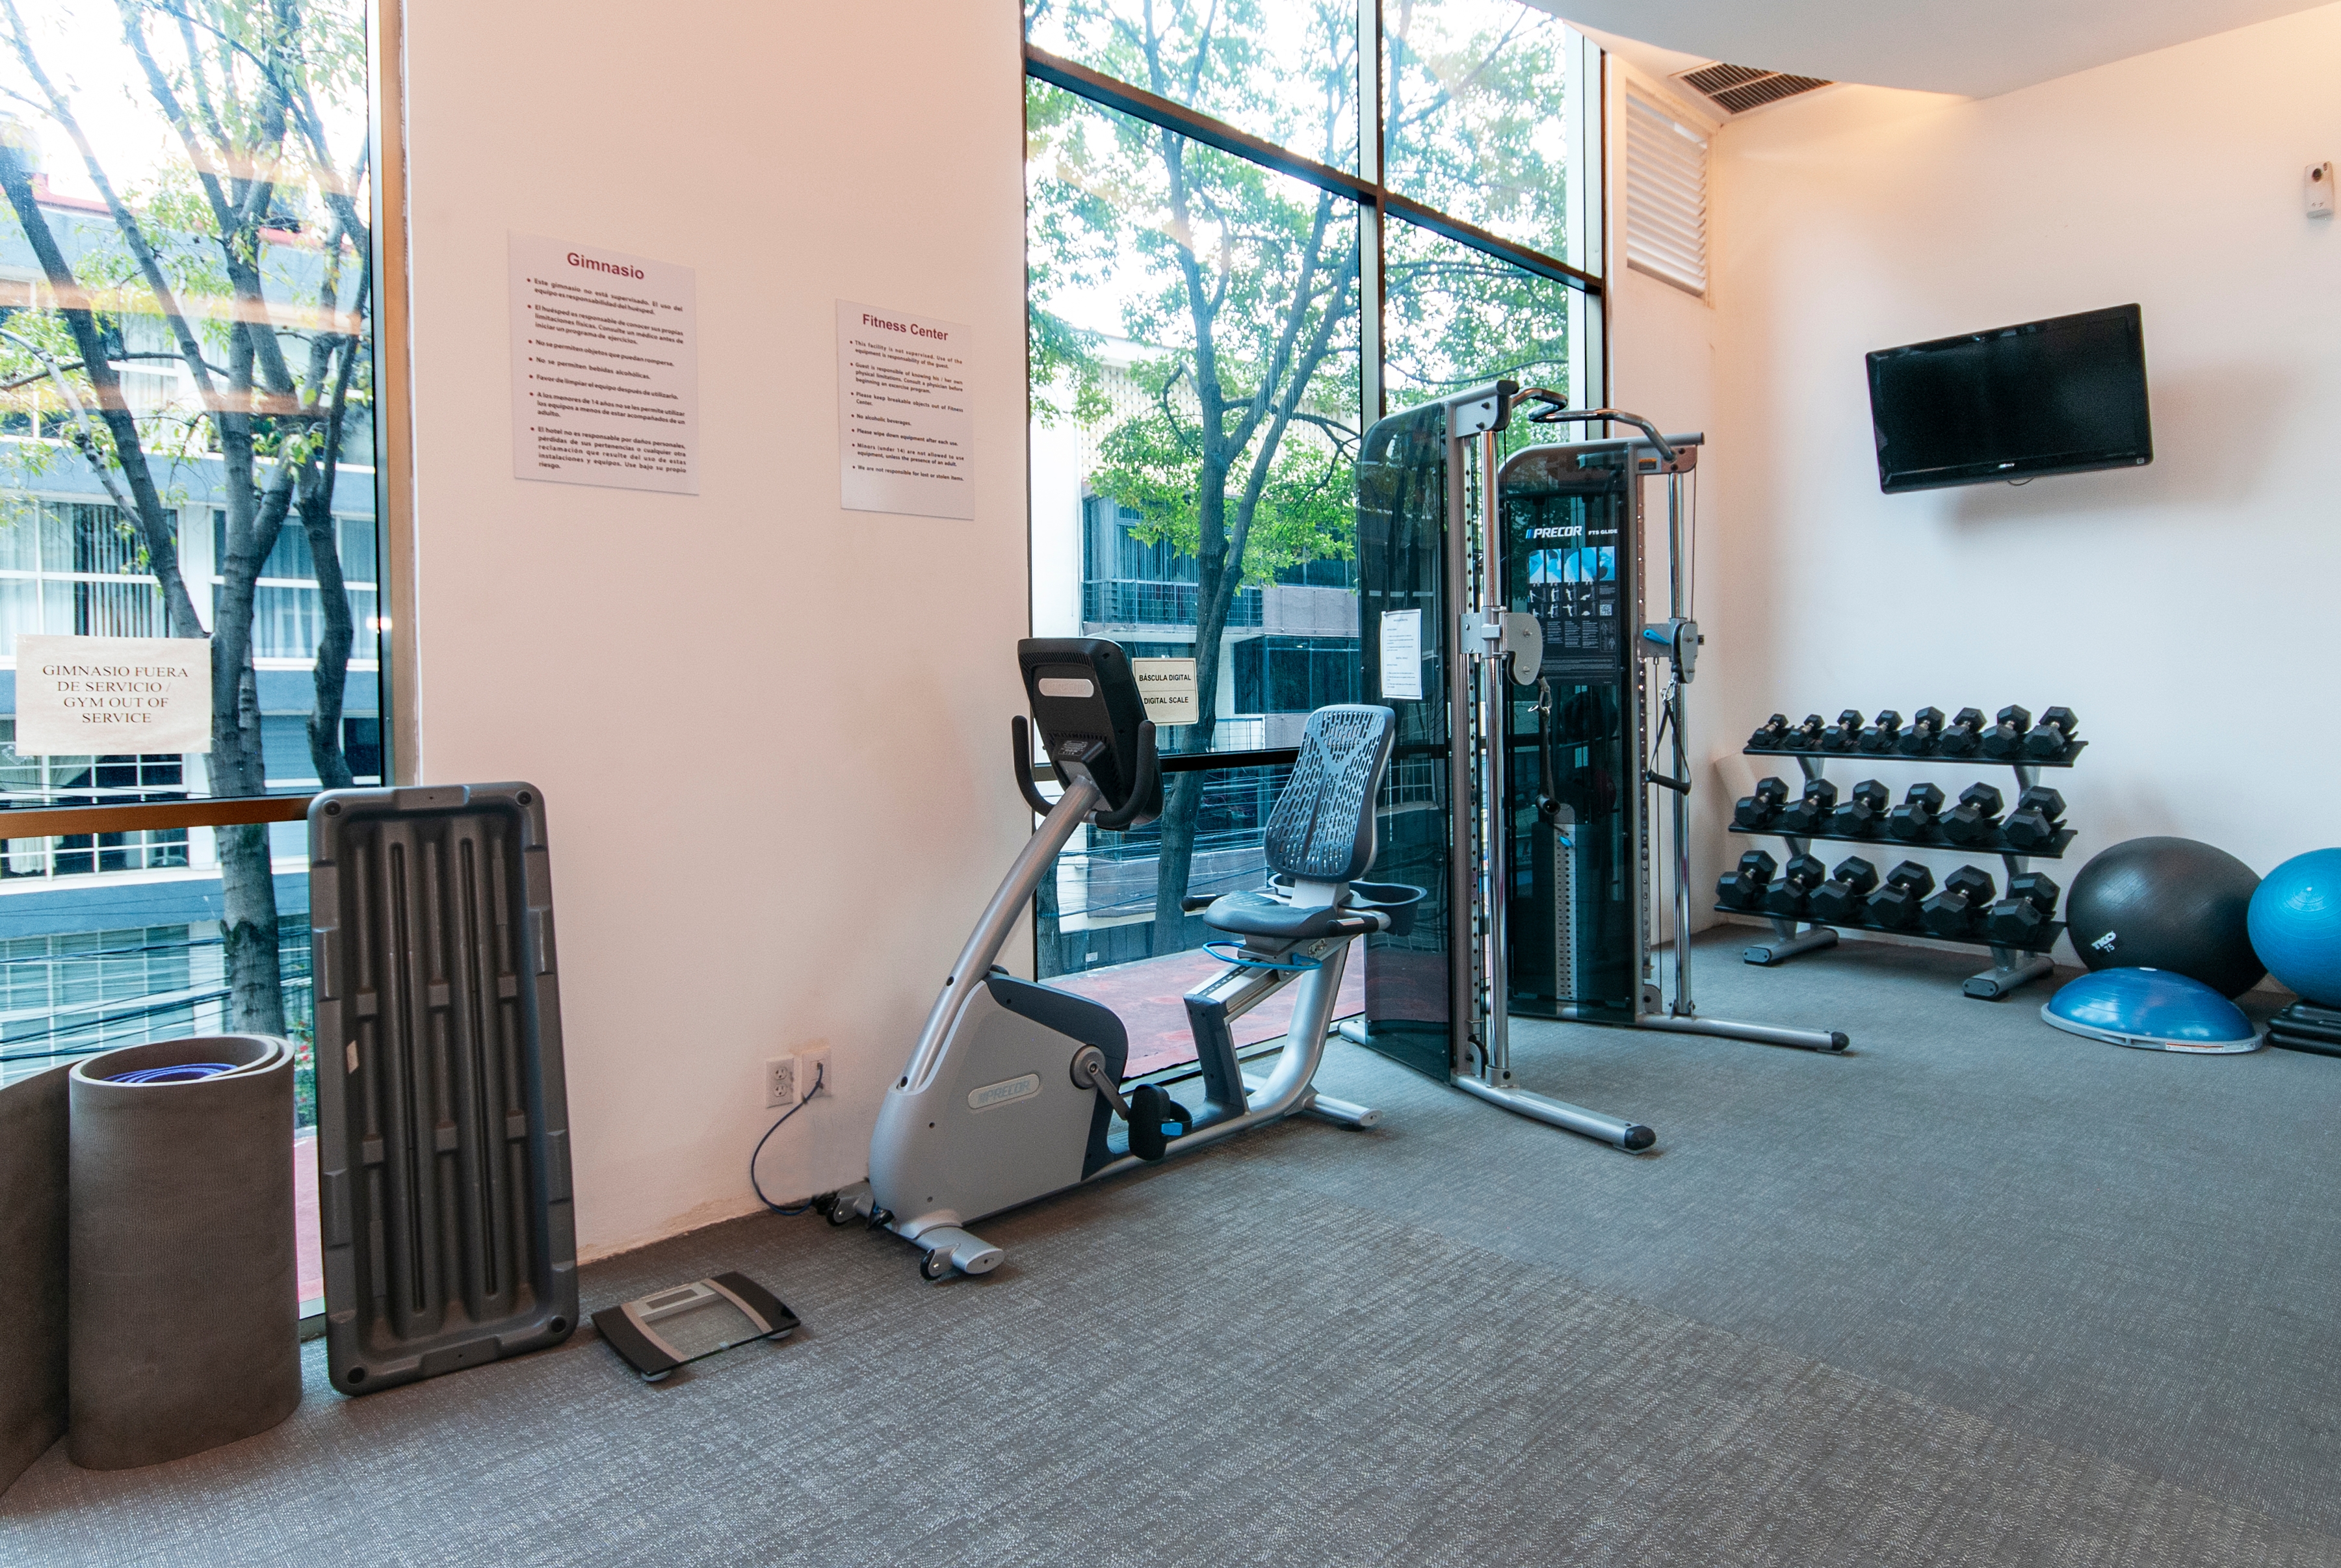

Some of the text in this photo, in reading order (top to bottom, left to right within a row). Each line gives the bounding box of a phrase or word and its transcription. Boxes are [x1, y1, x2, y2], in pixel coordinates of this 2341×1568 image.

[568, 253, 644, 280] Gimnasio
[551, 283, 581, 293] gimnasio
[535, 313, 575, 325] limitaciones
[599, 324, 625, 334] Consulte
[863, 314, 948, 340] Fitness Center
[868, 343, 886, 352] facility
[557, 361, 587, 370] permiten
[589, 365, 614, 374] bebidas
[856, 377, 880, 386] beginning
[627, 413, 668, 423] acompañados
[582, 433, 620, 441] responsable
[538, 445, 583, 454] reclamación
[594, 443, 634, 451] pertenencias
[539, 453, 583, 462] instalaciones
[1534, 526, 1582, 538] PRECOR
[43, 665, 188, 677] GIMNASIO FUERA
[1139, 673, 1168, 681] BÁSCULA
[58, 681, 79, 691] DE
[86, 682, 162, 692] SERVICIO
[64, 697, 168, 707] GYM OUT OF
[83, 712, 151, 723] SERVICE
[2091, 932, 2116, 950] TKO
[2104, 943, 2115, 952] 75
